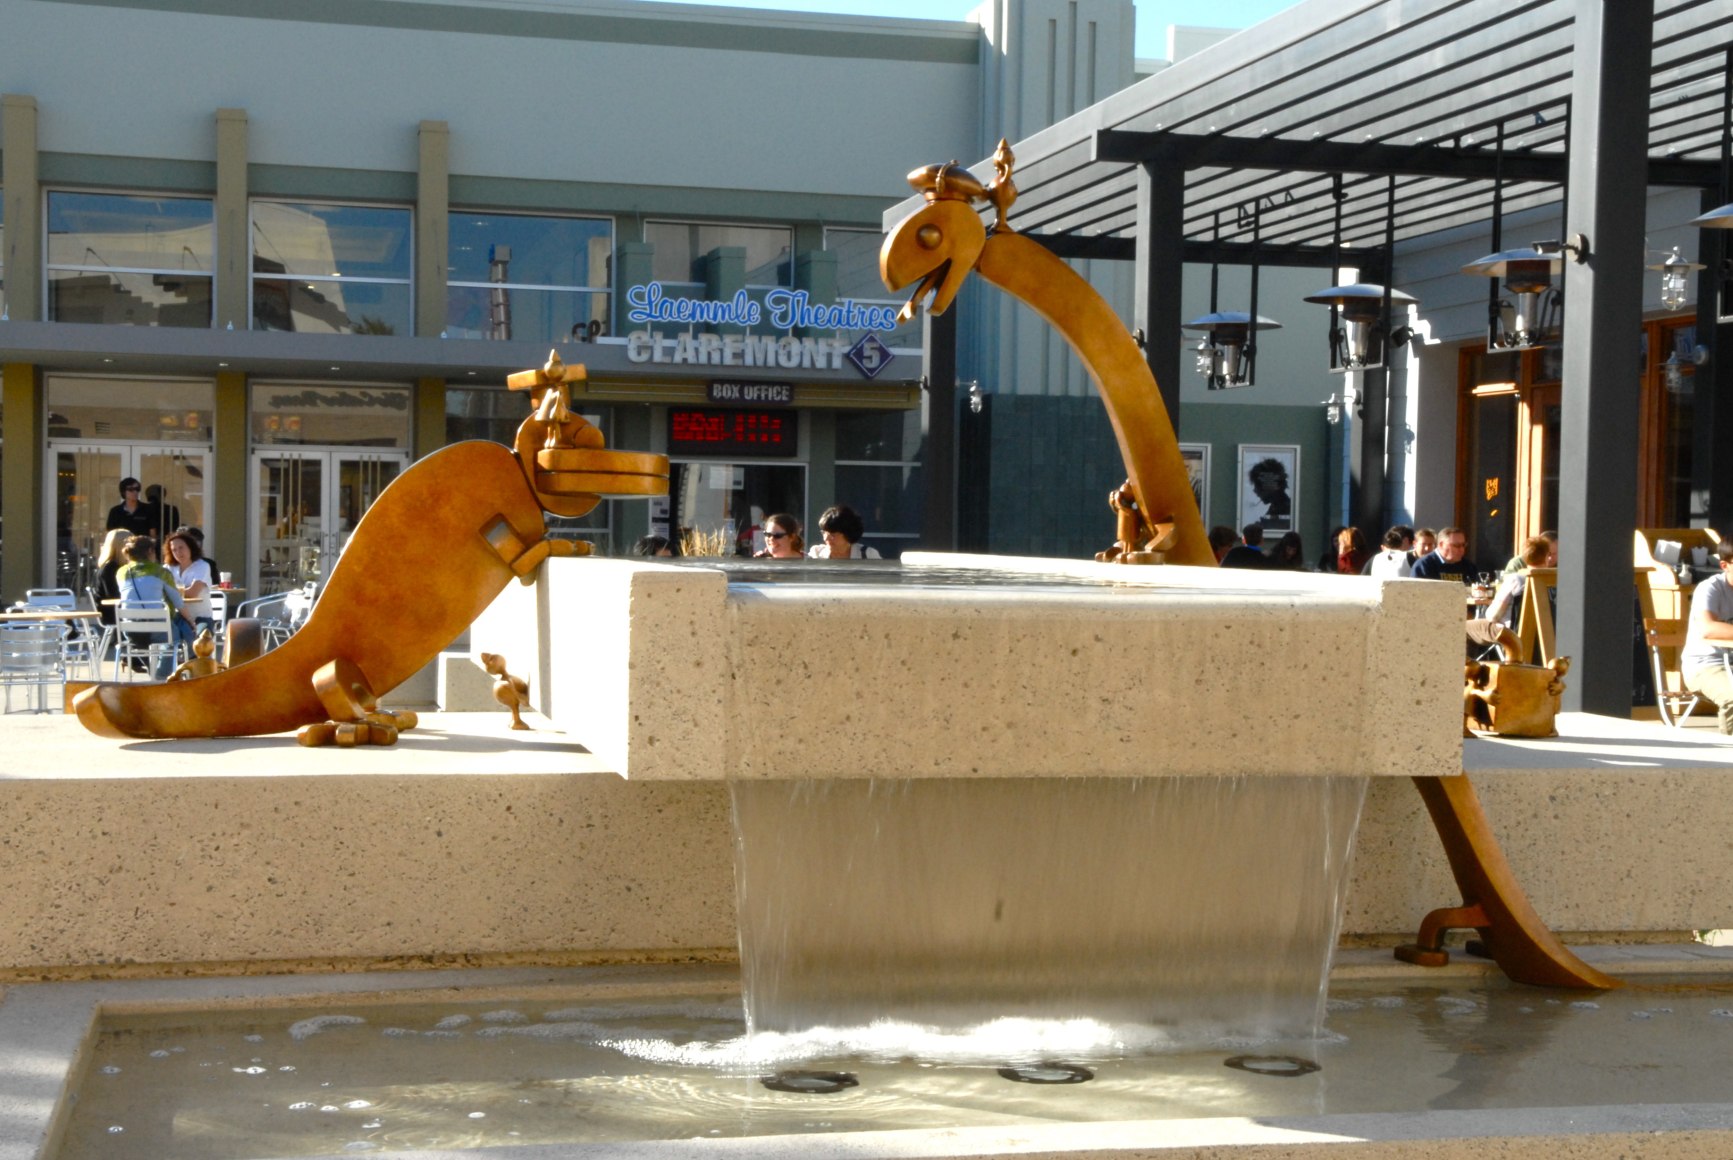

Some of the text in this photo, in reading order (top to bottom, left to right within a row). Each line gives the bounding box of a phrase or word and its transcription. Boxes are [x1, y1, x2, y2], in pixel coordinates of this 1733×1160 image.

[627, 281, 898, 331] Laemmle Theatres
[627, 331, 881, 370] CLAREMONT 5
[712, 383, 791, 401] BOX OFFICE
